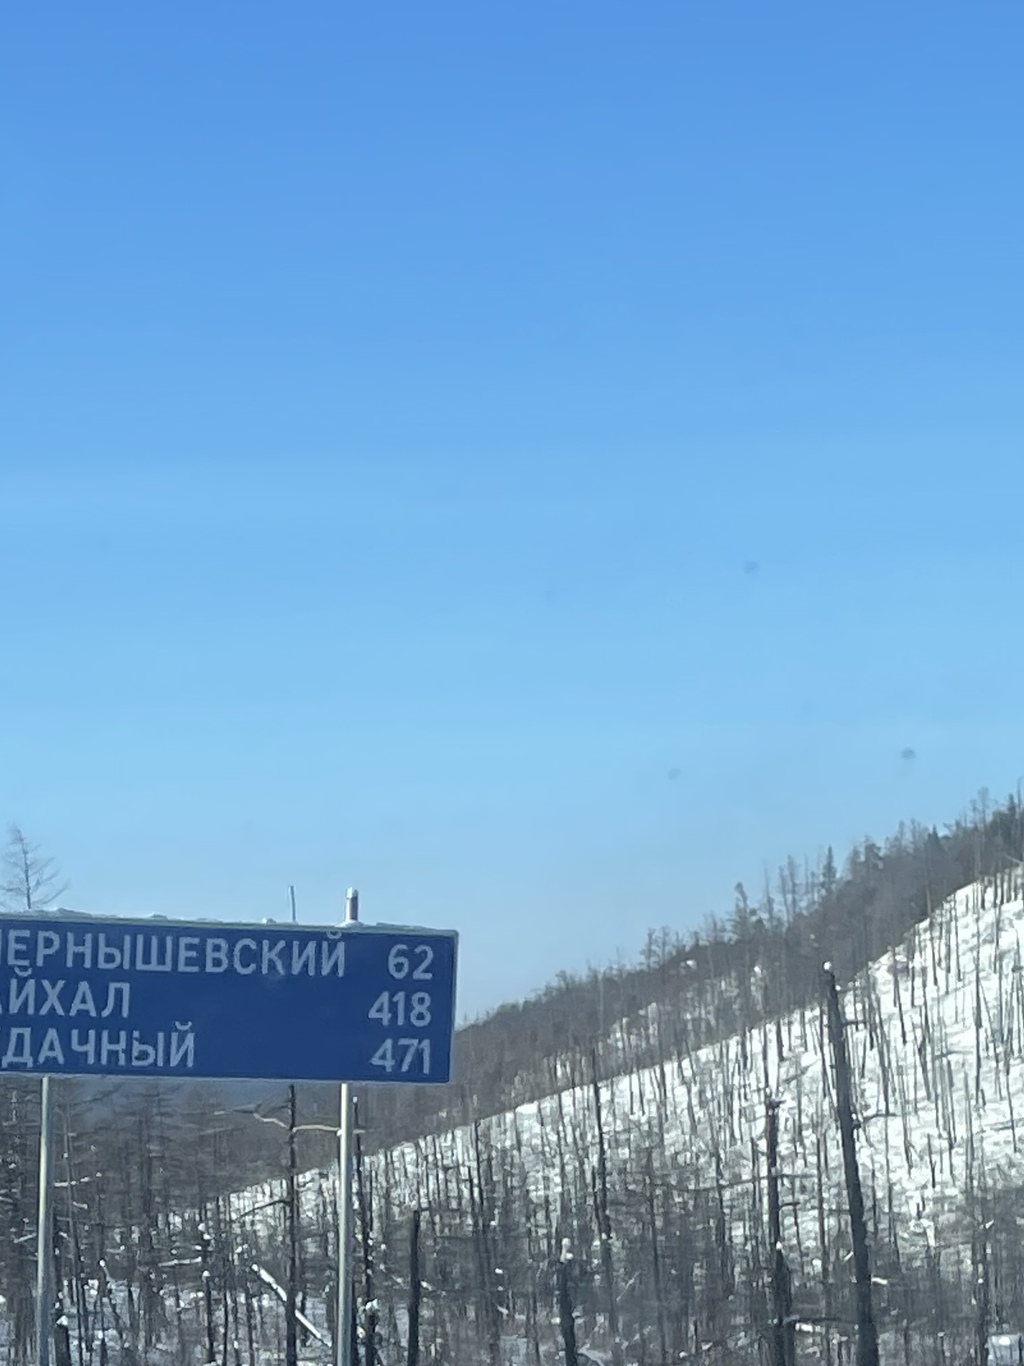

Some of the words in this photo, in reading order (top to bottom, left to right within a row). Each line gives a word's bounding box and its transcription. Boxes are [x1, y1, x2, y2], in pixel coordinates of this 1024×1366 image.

[388, 944, 434, 980] 62
[368, 991, 431, 1027] 418
[369, 1038, 431, 1075] 471
